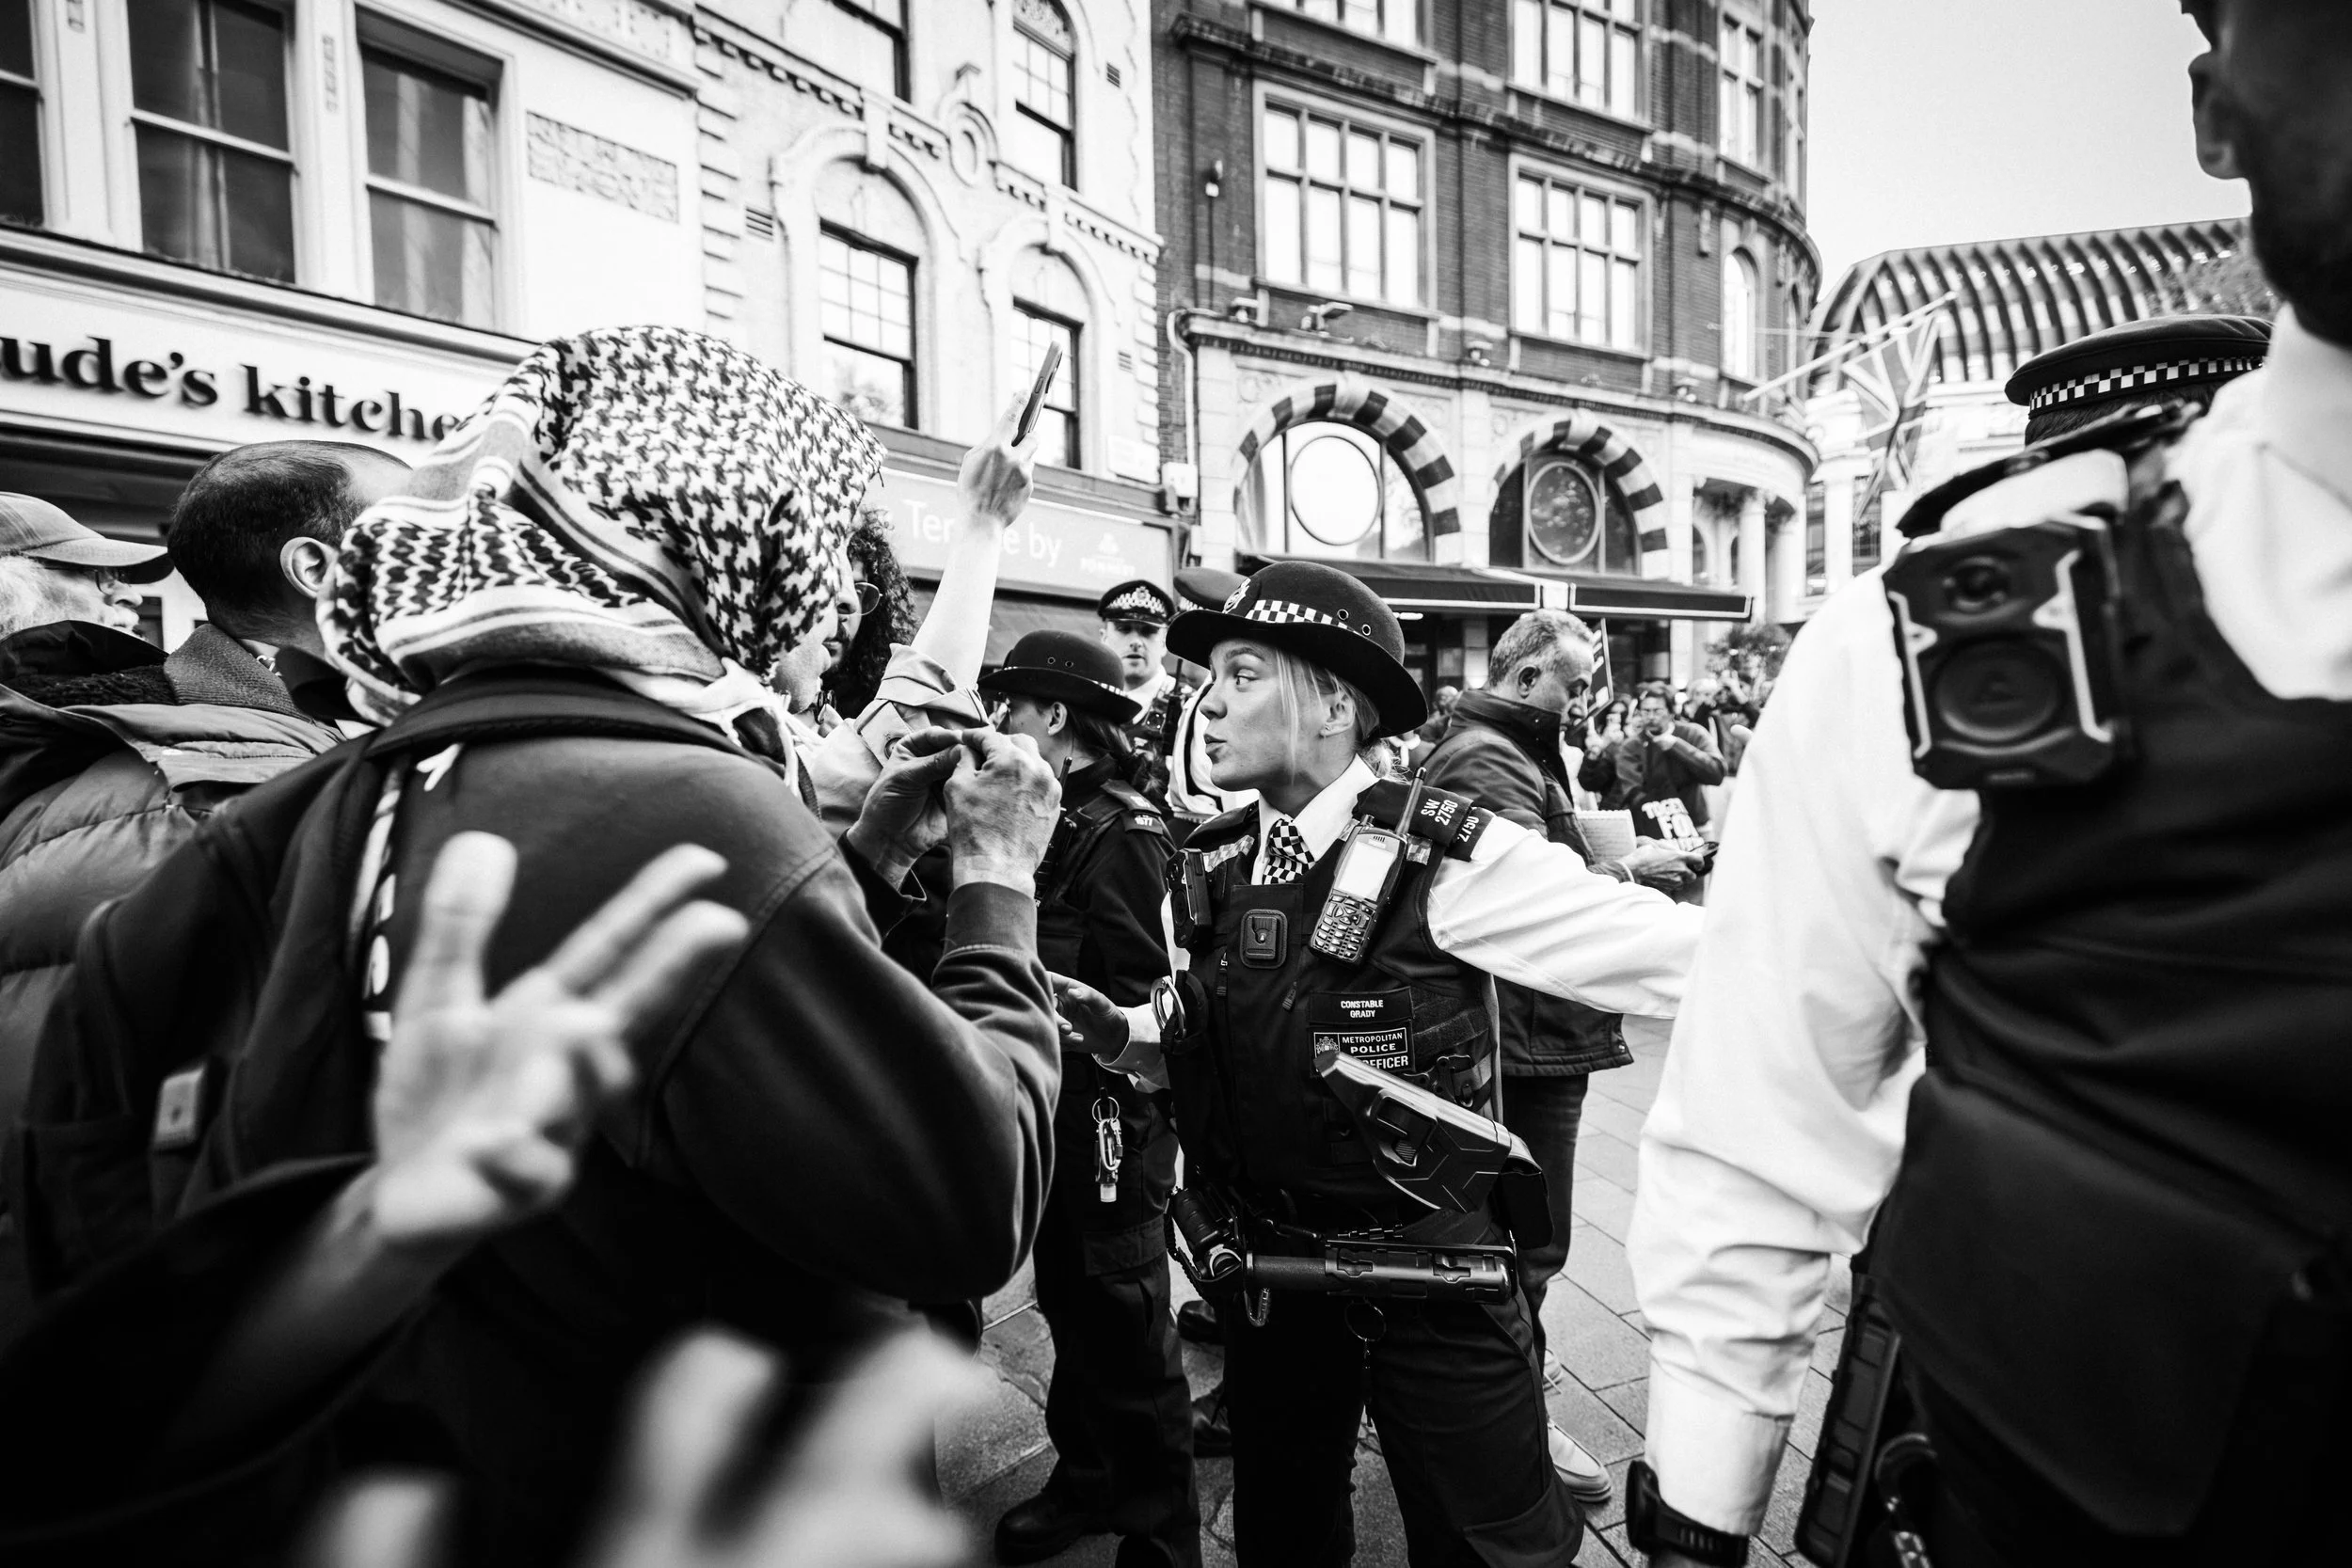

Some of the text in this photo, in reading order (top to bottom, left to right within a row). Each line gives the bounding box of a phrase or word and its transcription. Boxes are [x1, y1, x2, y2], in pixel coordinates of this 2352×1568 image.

[902, 499, 1062, 567] Tere by
[1420, 799, 1441, 816] SW
[1434, 800, 1458, 826] 2750
[1341, 999, 1384, 1009] CONSTABLE
[1350, 1009, 1375, 1019] GRADY
[1342, 1032, 1403, 1044] METROPOLITAN
[1350, 1043, 1396, 1054] POLICE
[1362, 1055, 1409, 1069] FFICER
